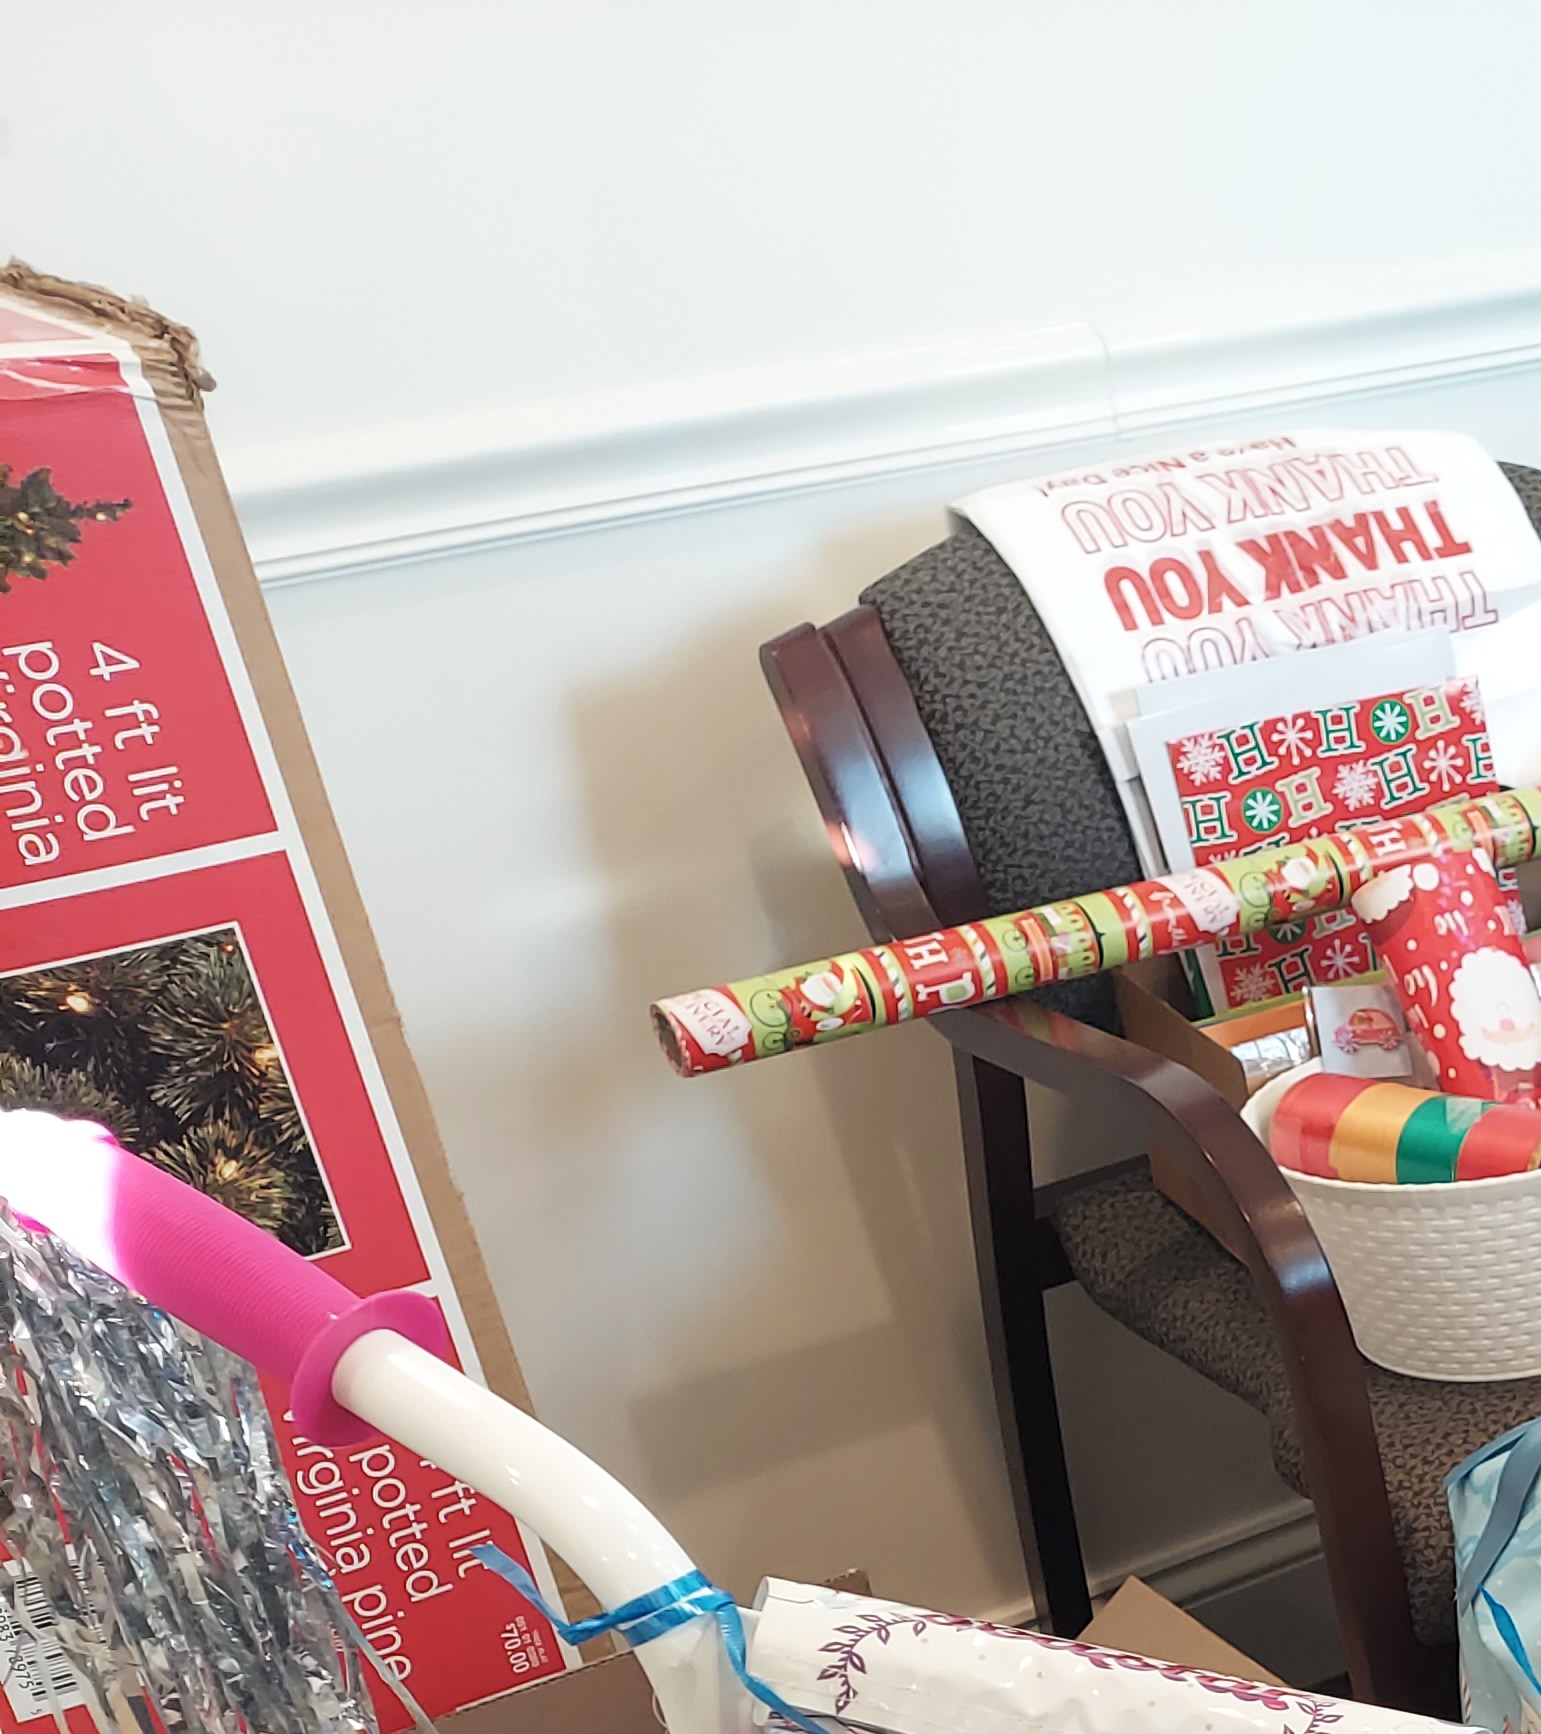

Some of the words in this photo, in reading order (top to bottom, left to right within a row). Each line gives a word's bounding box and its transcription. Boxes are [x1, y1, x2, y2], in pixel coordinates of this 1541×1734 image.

[1112, 457, 1187, 478] Nice
[1196, 446, 1440, 524] THANK
[1061, 480, 1215, 553] YOU
[1236, 500, 1473, 603] THANK
[1104, 550, 1249, 631] YOU
[1277, 571, 1499, 650] THANK
[89, 641, 141, 681] 4
[2, 641, 136, 841] potted
[104, 699, 161, 750] ft
[127, 765, 185, 821] lit
[349, 1444, 453, 1603] potted
[431, 1479, 477, 1524] ft
[341, 1584, 411, 1682] pine
[500, 1622, 530, 1673] $70.00
